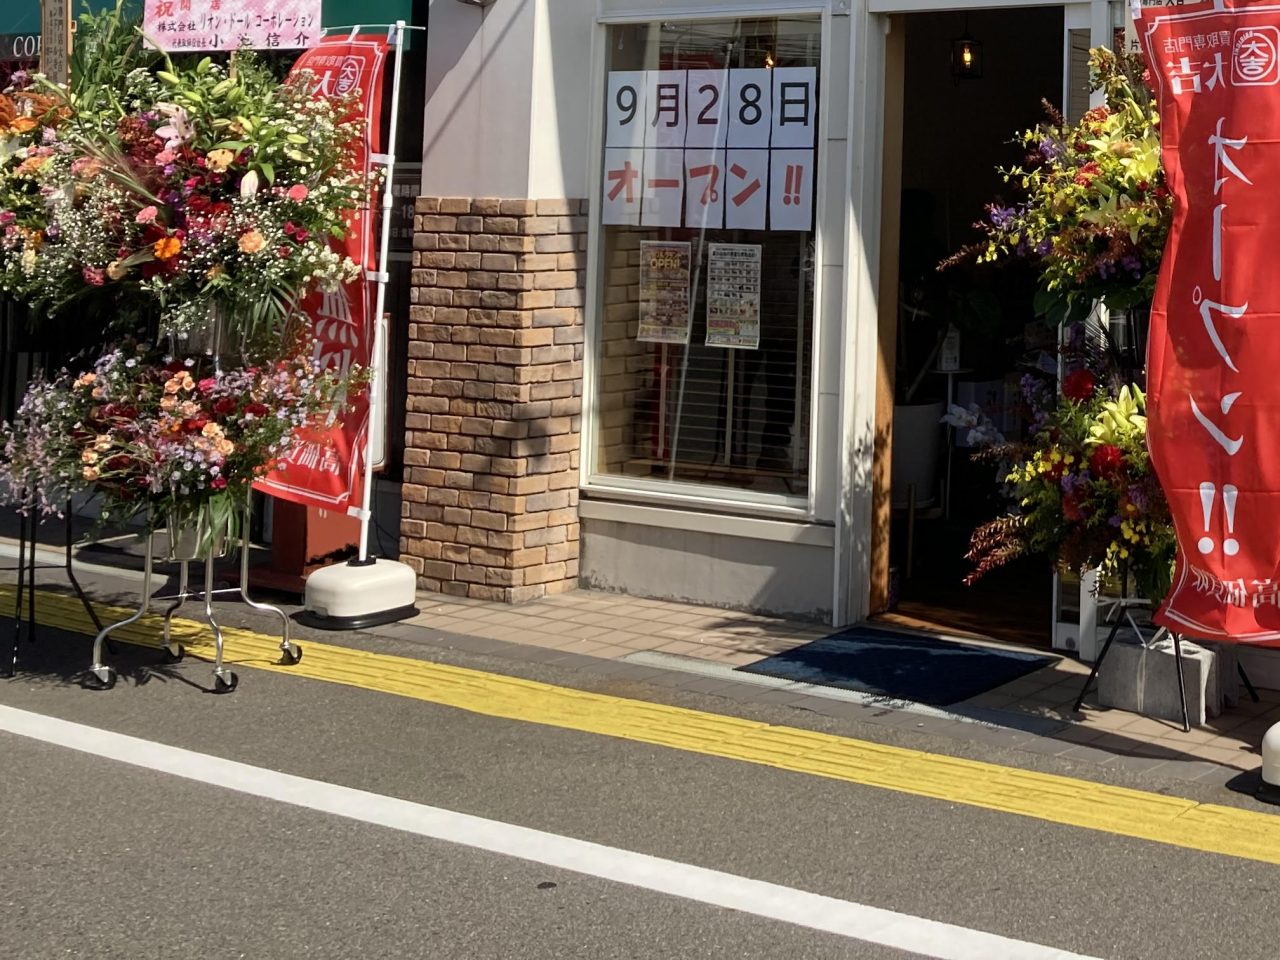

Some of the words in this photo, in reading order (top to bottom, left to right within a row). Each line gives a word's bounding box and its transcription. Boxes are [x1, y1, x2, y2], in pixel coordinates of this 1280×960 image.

[154, 0, 174, 18] 祝
[157, 21, 197, 32] 株式会社
[615, 82, 810, 128] 9月28日
